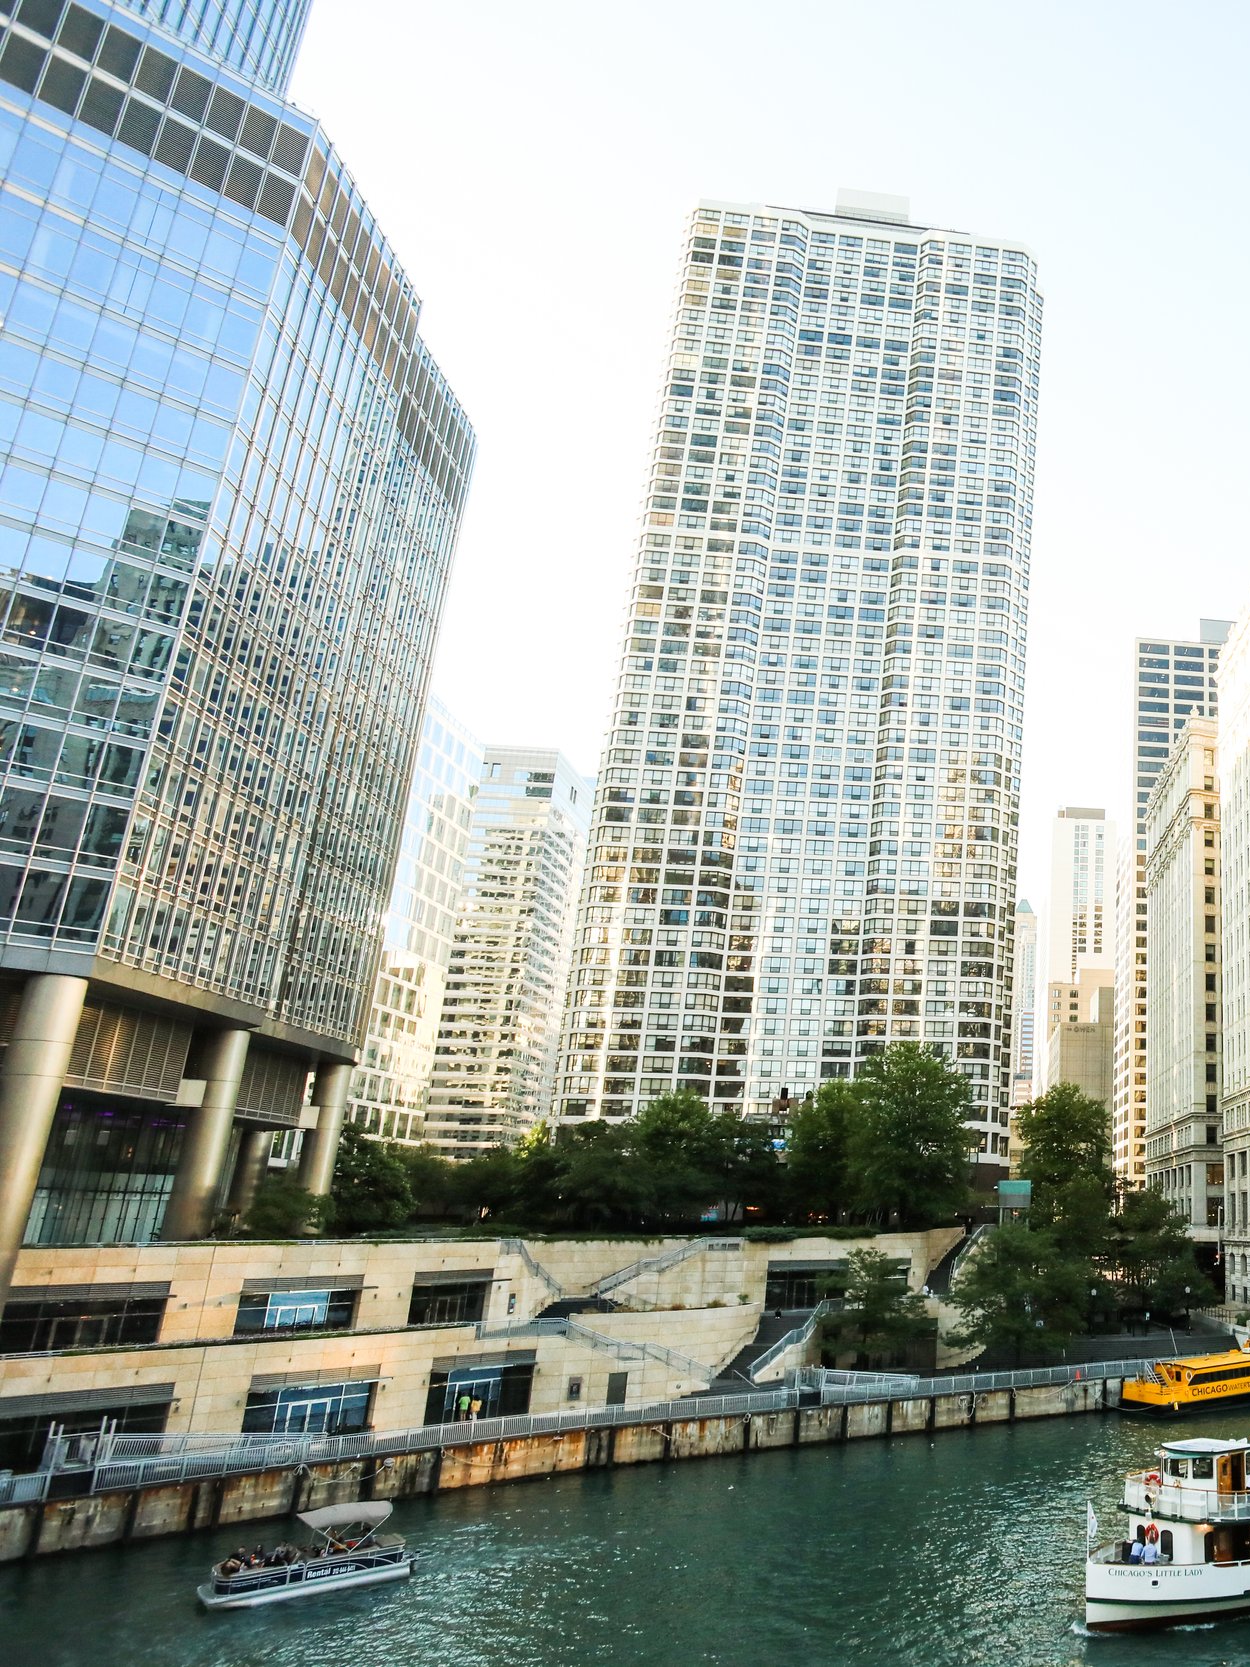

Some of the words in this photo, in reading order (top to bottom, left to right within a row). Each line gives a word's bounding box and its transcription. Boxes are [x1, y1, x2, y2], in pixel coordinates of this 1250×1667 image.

[1191, 1384, 1228, 1397] CHICAGO
[306, 1567, 332, 1579] Rental
[1108, 1567, 1153, 1578] CHICAGO'S
[1155, 1568, 1182, 1577] LITTLE
[1184, 1568, 1204, 1577] LADY
